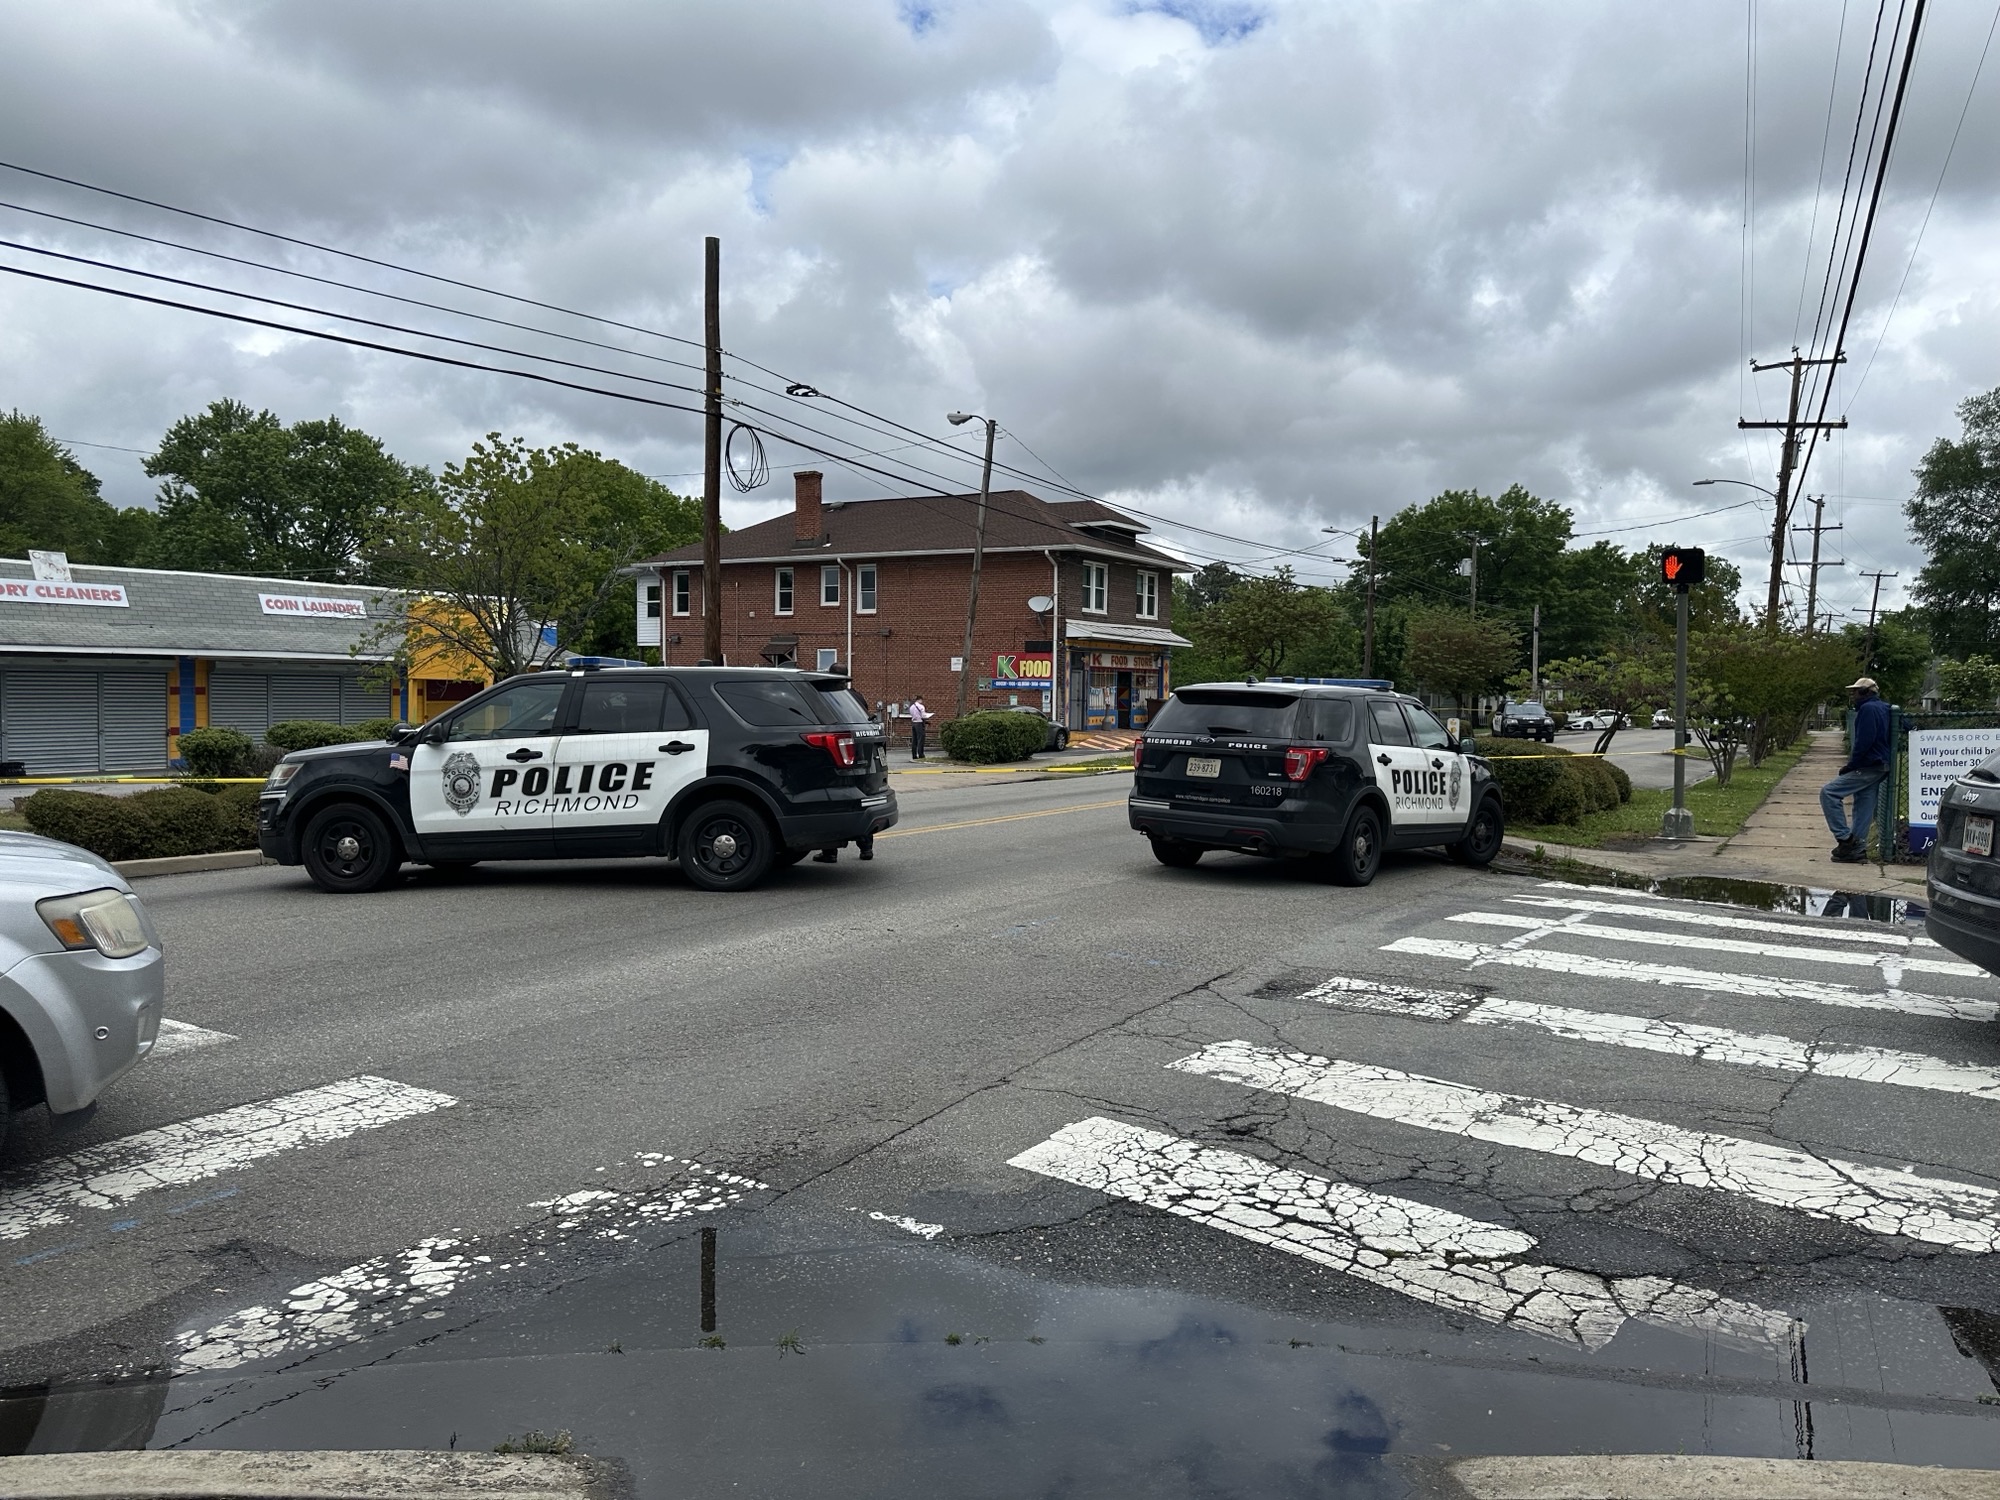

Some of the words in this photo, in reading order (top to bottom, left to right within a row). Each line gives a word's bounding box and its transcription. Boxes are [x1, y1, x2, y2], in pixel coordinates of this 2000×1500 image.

[35, 586, 122, 601] CLEANERS
[265, 599, 299, 610] COIN
[302, 601, 361, 613] LAUNDRY
[1092, 653, 1102, 666] K
[1111, 656, 1128, 666] FOOD
[1133, 656, 1153, 667] STORE
[997, 655, 1018, 679] K
[1019, 660, 1051, 678] FOOD
[1147, 737, 1192, 746] RICHMOND
[1228, 742, 1268, 750] POLICE
[1920, 748, 1937, 756] Will
[1939, 749, 1959, 757] your
[1961, 747, 1982, 756] child
[1920, 758, 1968, 769] September
[446, 768, 477, 780] POLICE
[490, 761, 656, 798] POLICE
[1920, 772, 1942, 781] Have
[1391, 769, 1447, 795] POLICE
[1250, 785, 1282, 797] 160218
[495, 794, 639, 816] RICHMOND
[1395, 797, 1444, 810] RICHMOND
